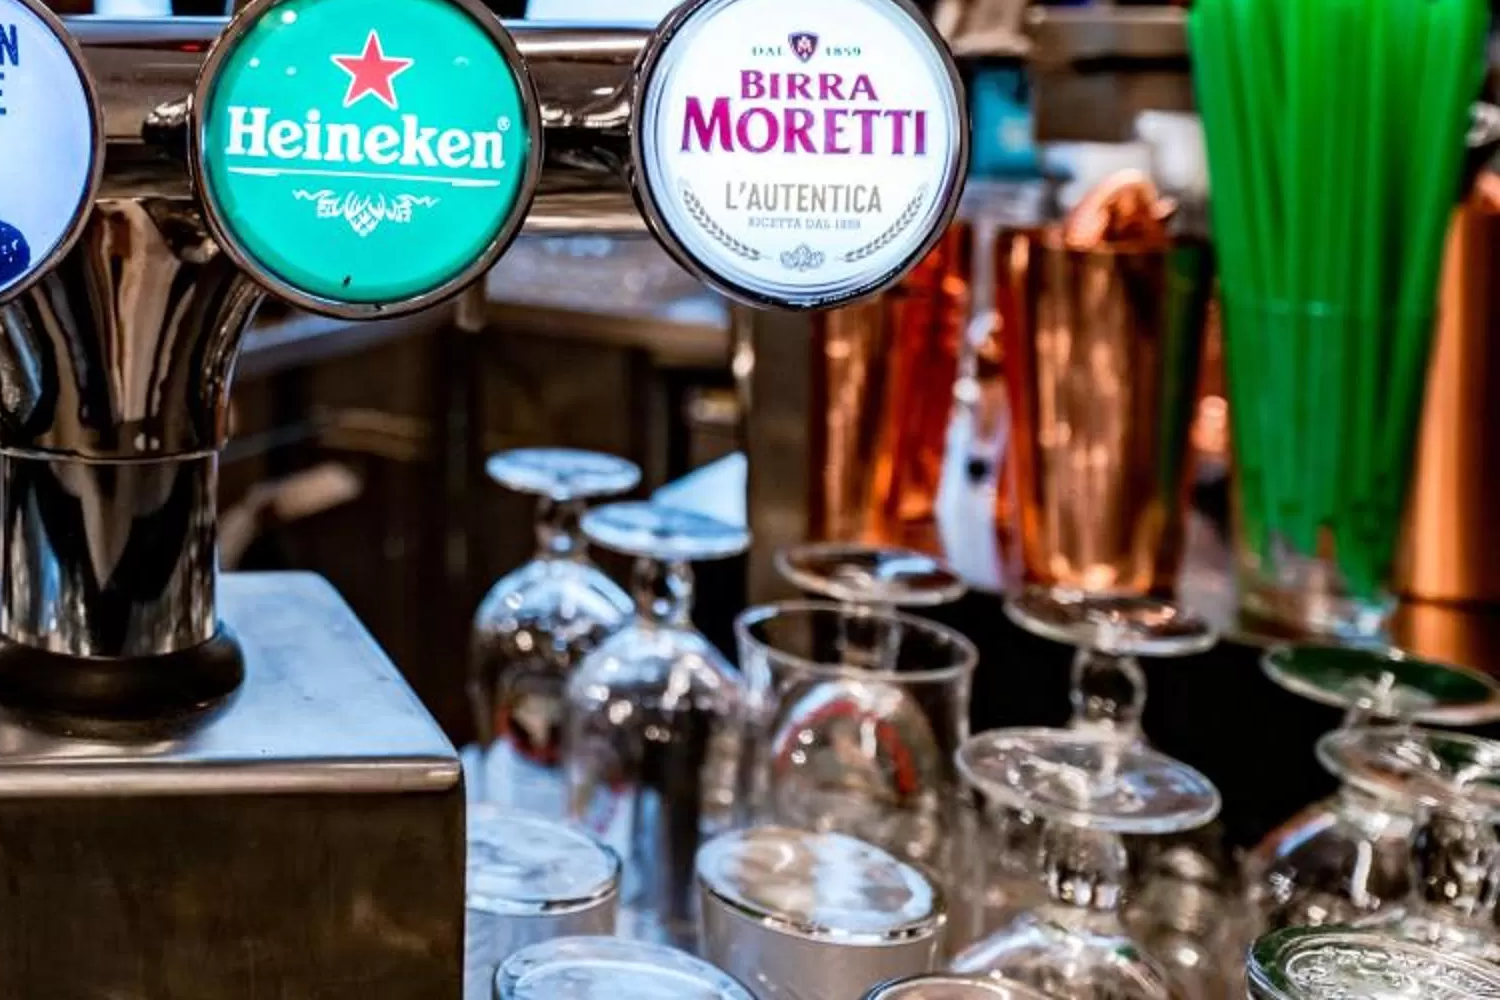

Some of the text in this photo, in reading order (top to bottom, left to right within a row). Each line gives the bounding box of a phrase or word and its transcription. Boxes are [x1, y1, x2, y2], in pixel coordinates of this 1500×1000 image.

[739, 69, 879, 101] BIRRA
[225, 106, 506, 169] Heineken
[680, 95, 929, 156] MORETTI
[725, 181, 883, 214] L'AUTENTICA
